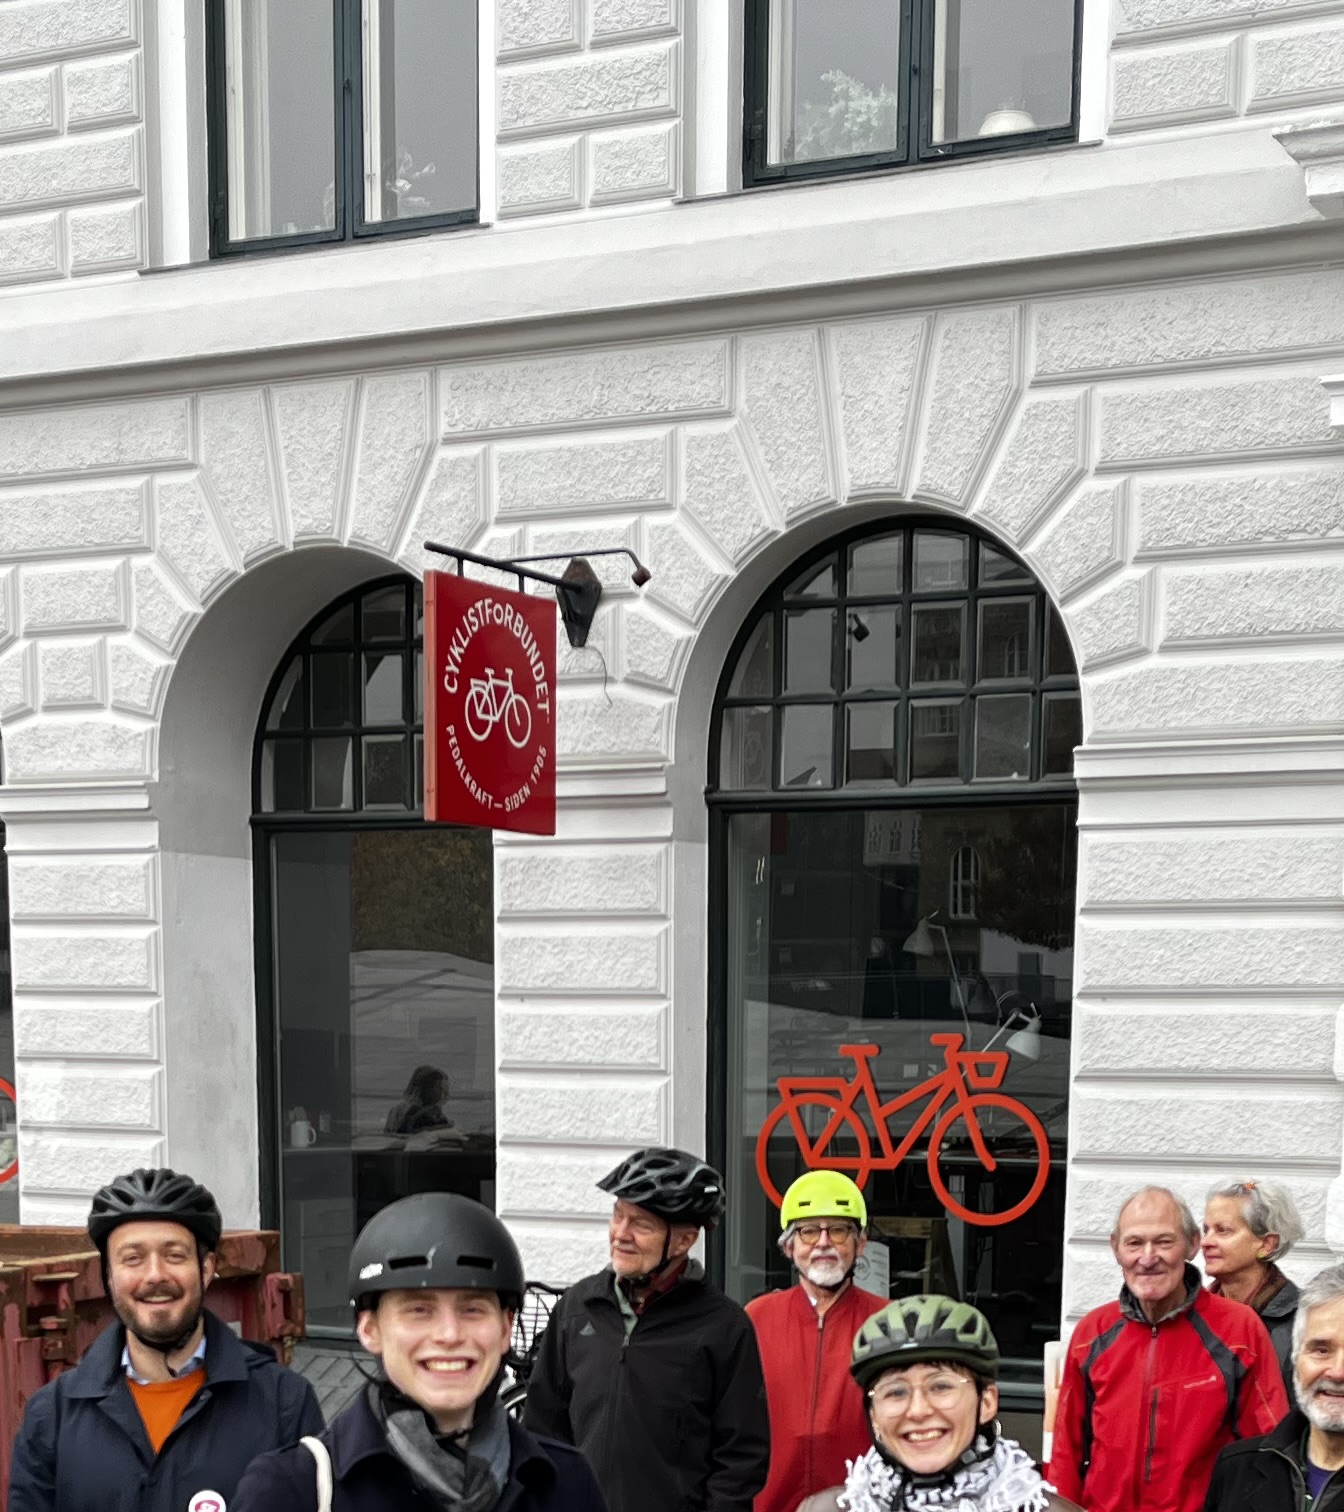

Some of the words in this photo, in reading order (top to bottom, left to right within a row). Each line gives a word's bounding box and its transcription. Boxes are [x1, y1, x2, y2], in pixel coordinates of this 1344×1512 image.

[444, 597, 550, 714] CYKLISTFORBUNDET
[445, 724, 494, 810] PEDALKRAFT
[505, 783, 531, 813] SIDEN
